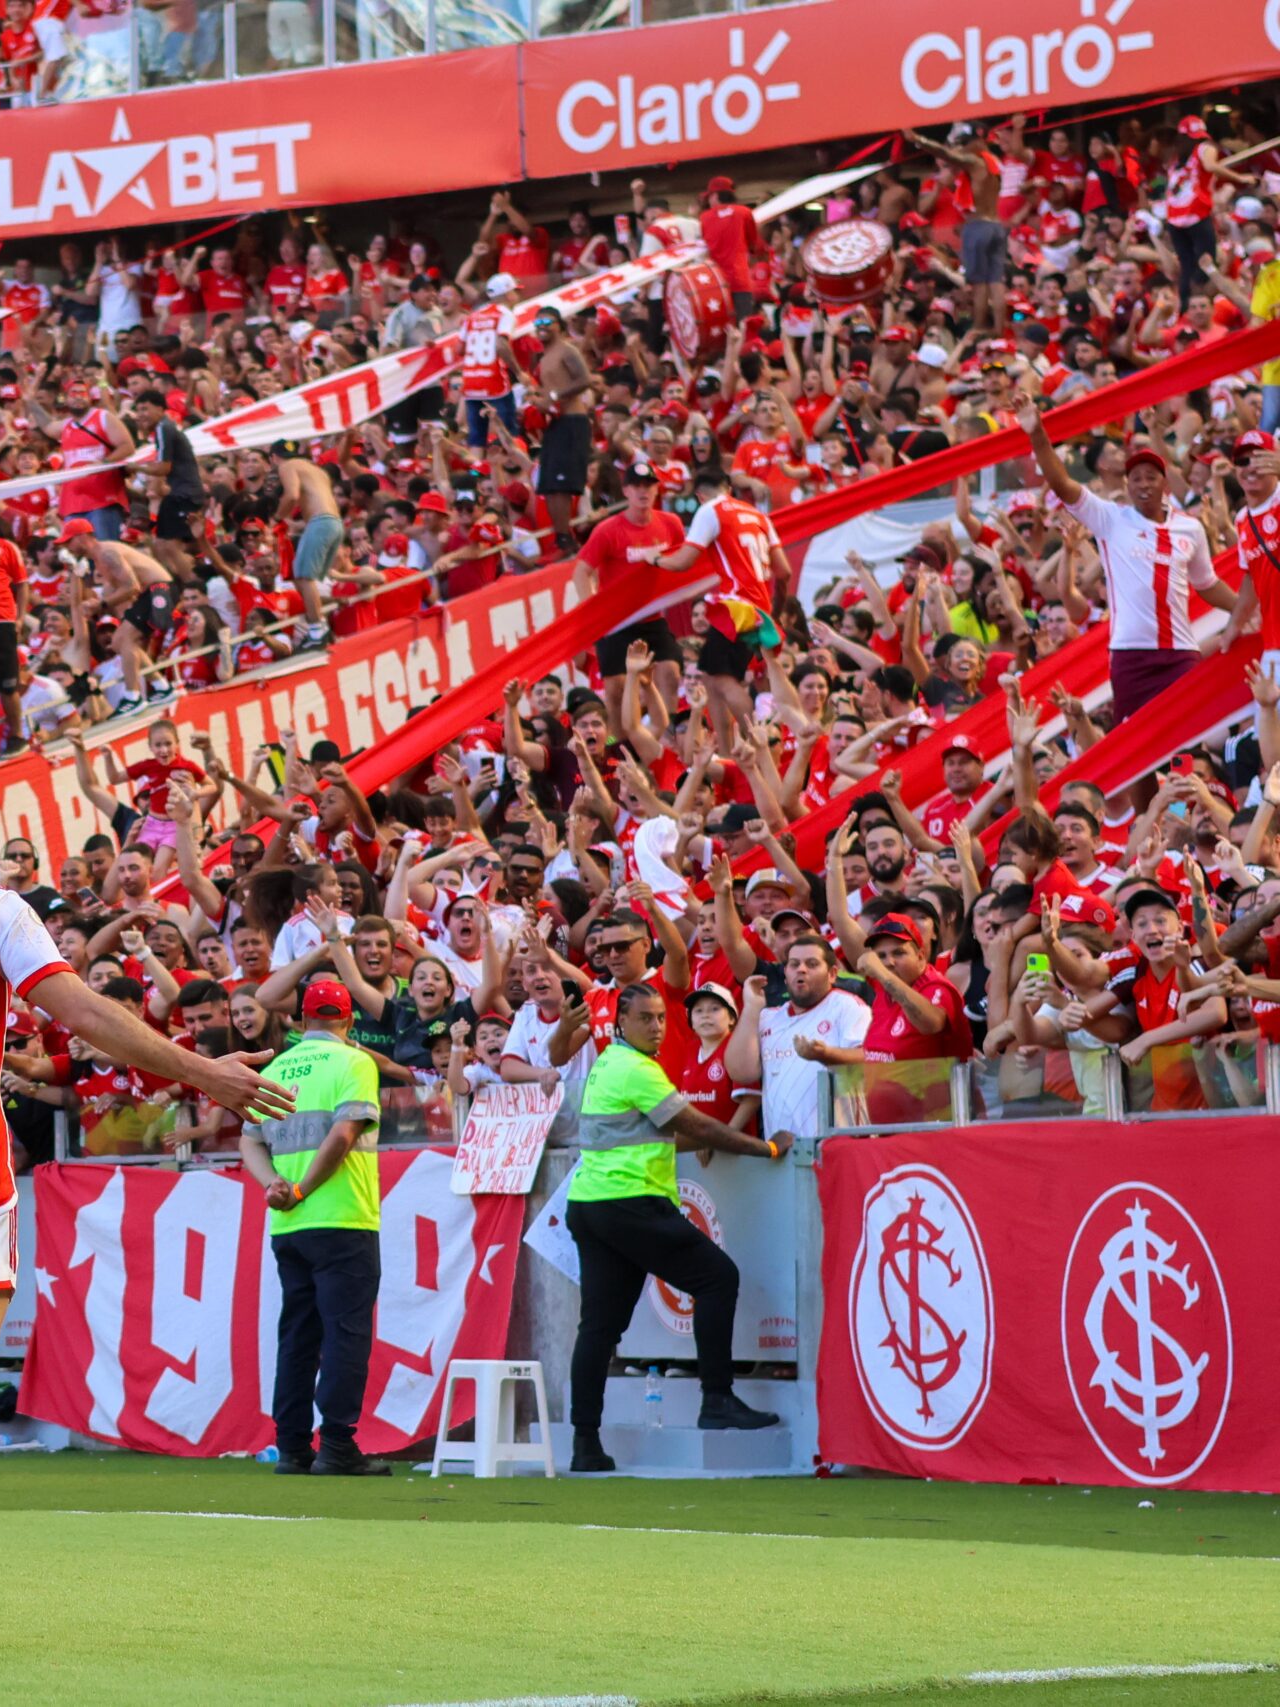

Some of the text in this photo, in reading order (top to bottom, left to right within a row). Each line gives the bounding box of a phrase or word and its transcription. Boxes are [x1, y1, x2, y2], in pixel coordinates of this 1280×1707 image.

[901, 24, 1115, 110] Claro
[557, 73, 764, 154] Claro
[167, 122, 311, 207] BET
[465, 330, 496, 366] 98
[280, 1064, 312, 1081] 1358
[69, 1150, 477, 1445] 199
[674, 1319, 691, 1332] 190
